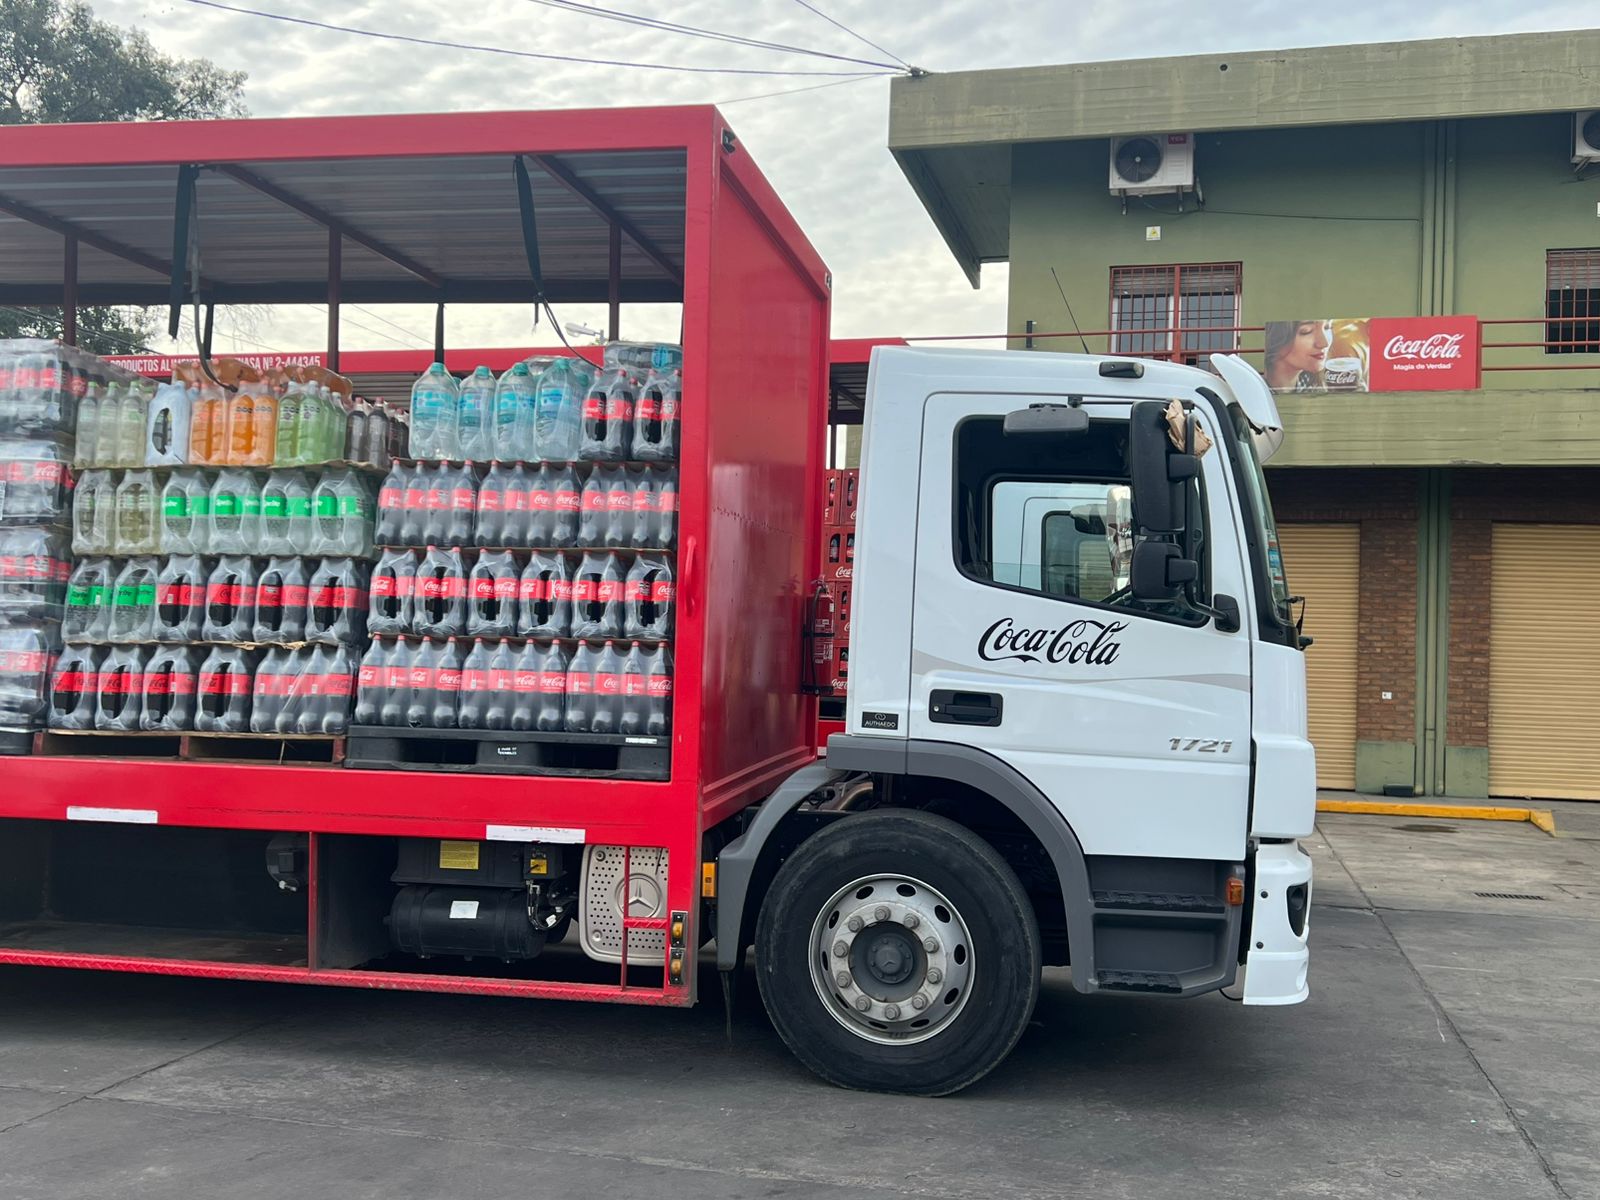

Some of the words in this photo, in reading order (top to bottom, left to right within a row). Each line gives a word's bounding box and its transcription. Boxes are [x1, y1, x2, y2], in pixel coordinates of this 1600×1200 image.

[1383, 333, 1464, 360] Coca-Cola
[1393, 363, 1415, 371] Magia
[1426, 362, 1452, 370] Verdad
[978, 617, 1132, 665] Coca-Cola
[1168, 736, 1233, 753] 1721
